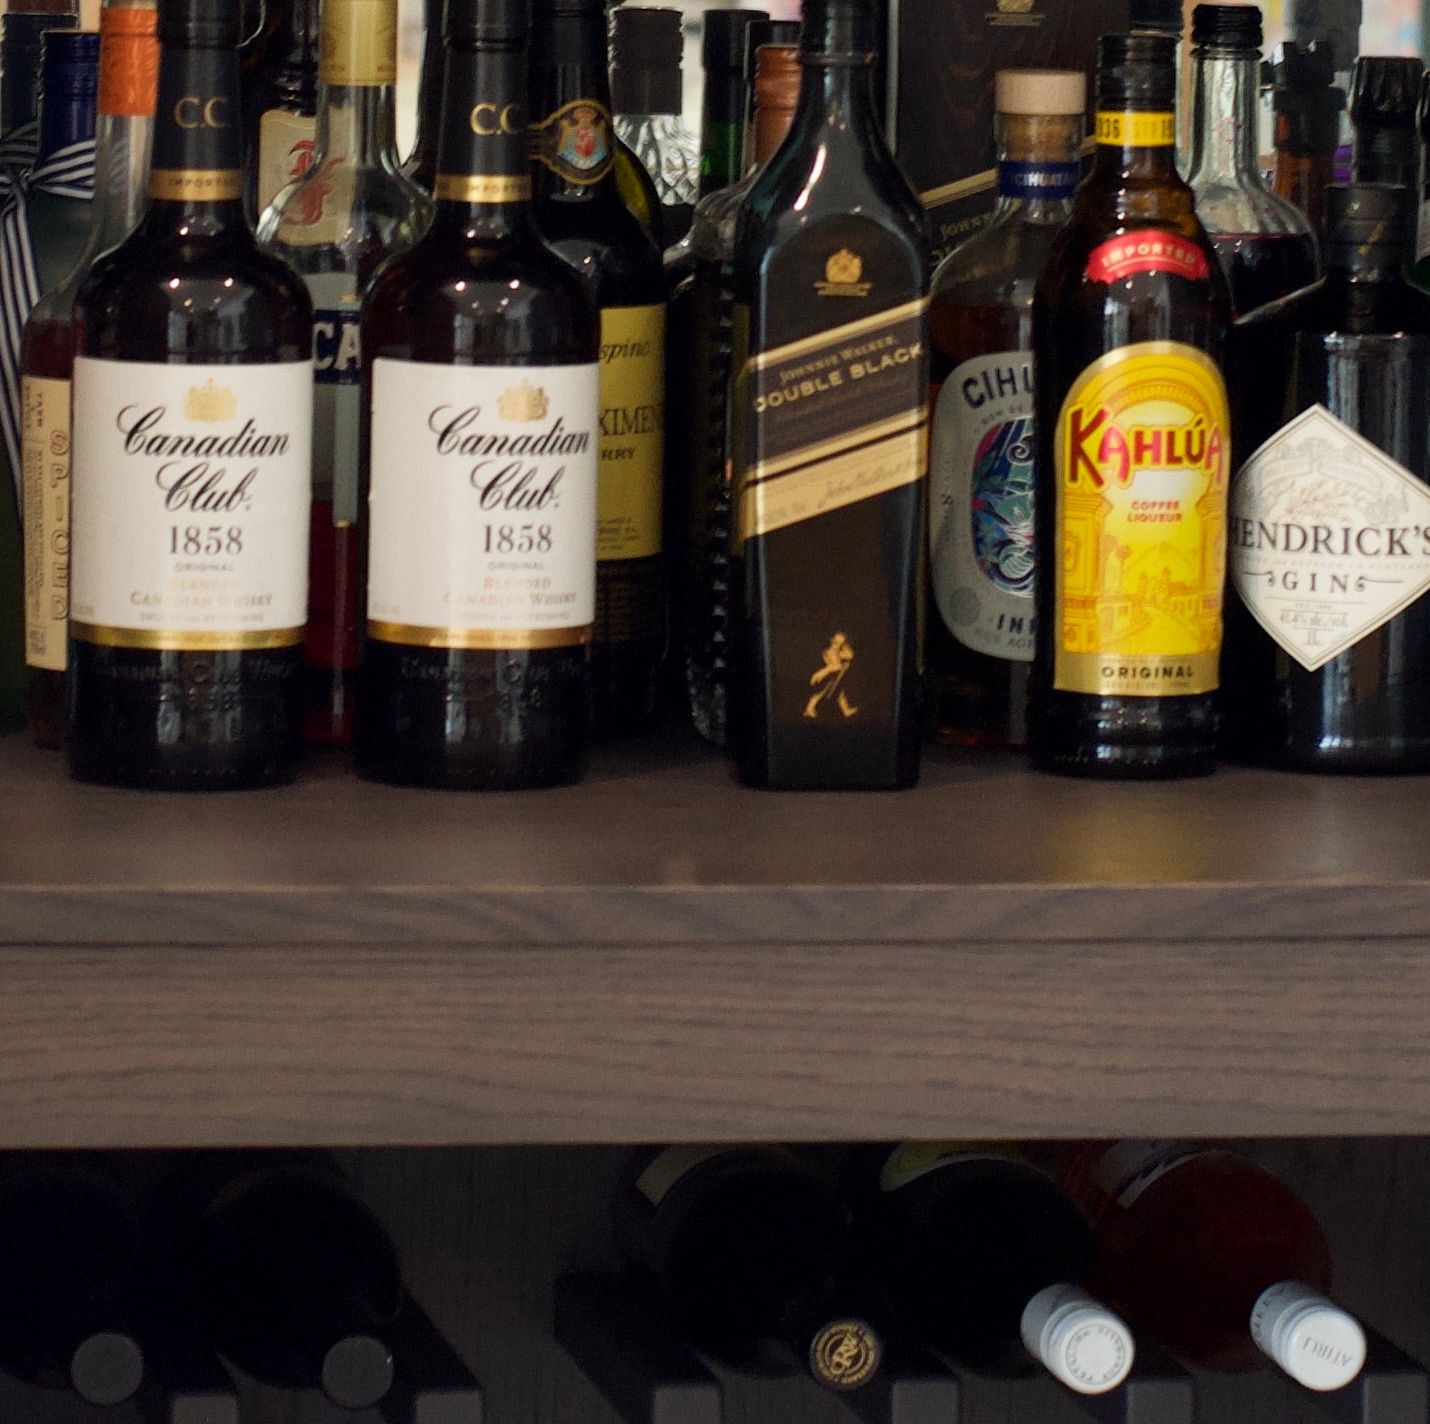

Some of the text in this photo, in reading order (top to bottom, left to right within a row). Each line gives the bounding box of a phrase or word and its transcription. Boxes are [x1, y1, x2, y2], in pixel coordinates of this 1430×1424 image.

[1100, 242, 1197, 268] IMPORTED
[754, 341, 923, 414] DOUBLE BLACK
[116, 403, 291, 458] Canadian
[427, 403, 591, 457] Canadian
[1067, 406, 1224, 488] KAHLÚA
[1126, 512, 1183, 524] LIQUEUR
[1130, 500, 1181, 510] COFFEE
[167, 525, 244, 556] 1858
[482, 524, 553, 555] 1858
[1281, 570, 1349, 594] GIN
[1100, 666, 1195, 680] ORIGINAL
